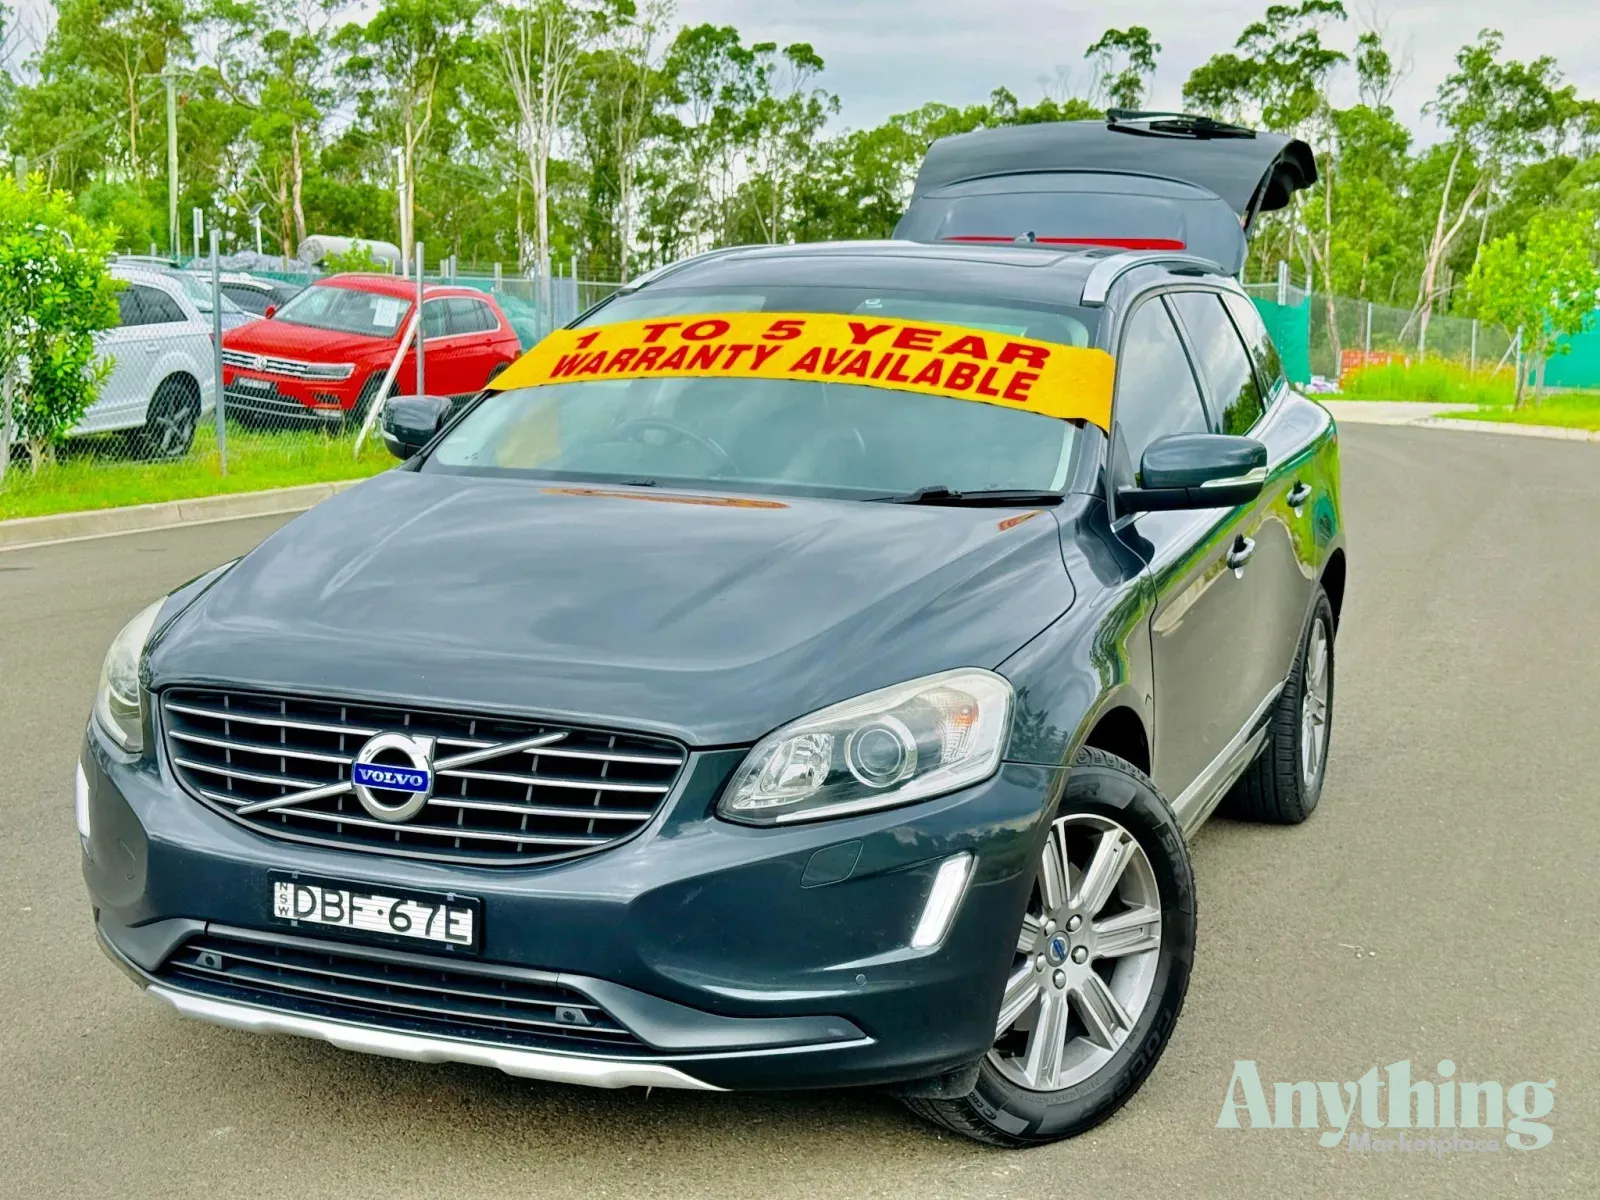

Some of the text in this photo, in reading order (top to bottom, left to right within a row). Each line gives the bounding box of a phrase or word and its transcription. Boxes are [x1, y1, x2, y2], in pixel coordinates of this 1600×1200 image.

[577, 319, 1051, 370] 1 TO 5 YEAR
[549, 343, 1040, 402] WARRANTY AVAILABLE
[358, 768, 424, 787] VOLVO
